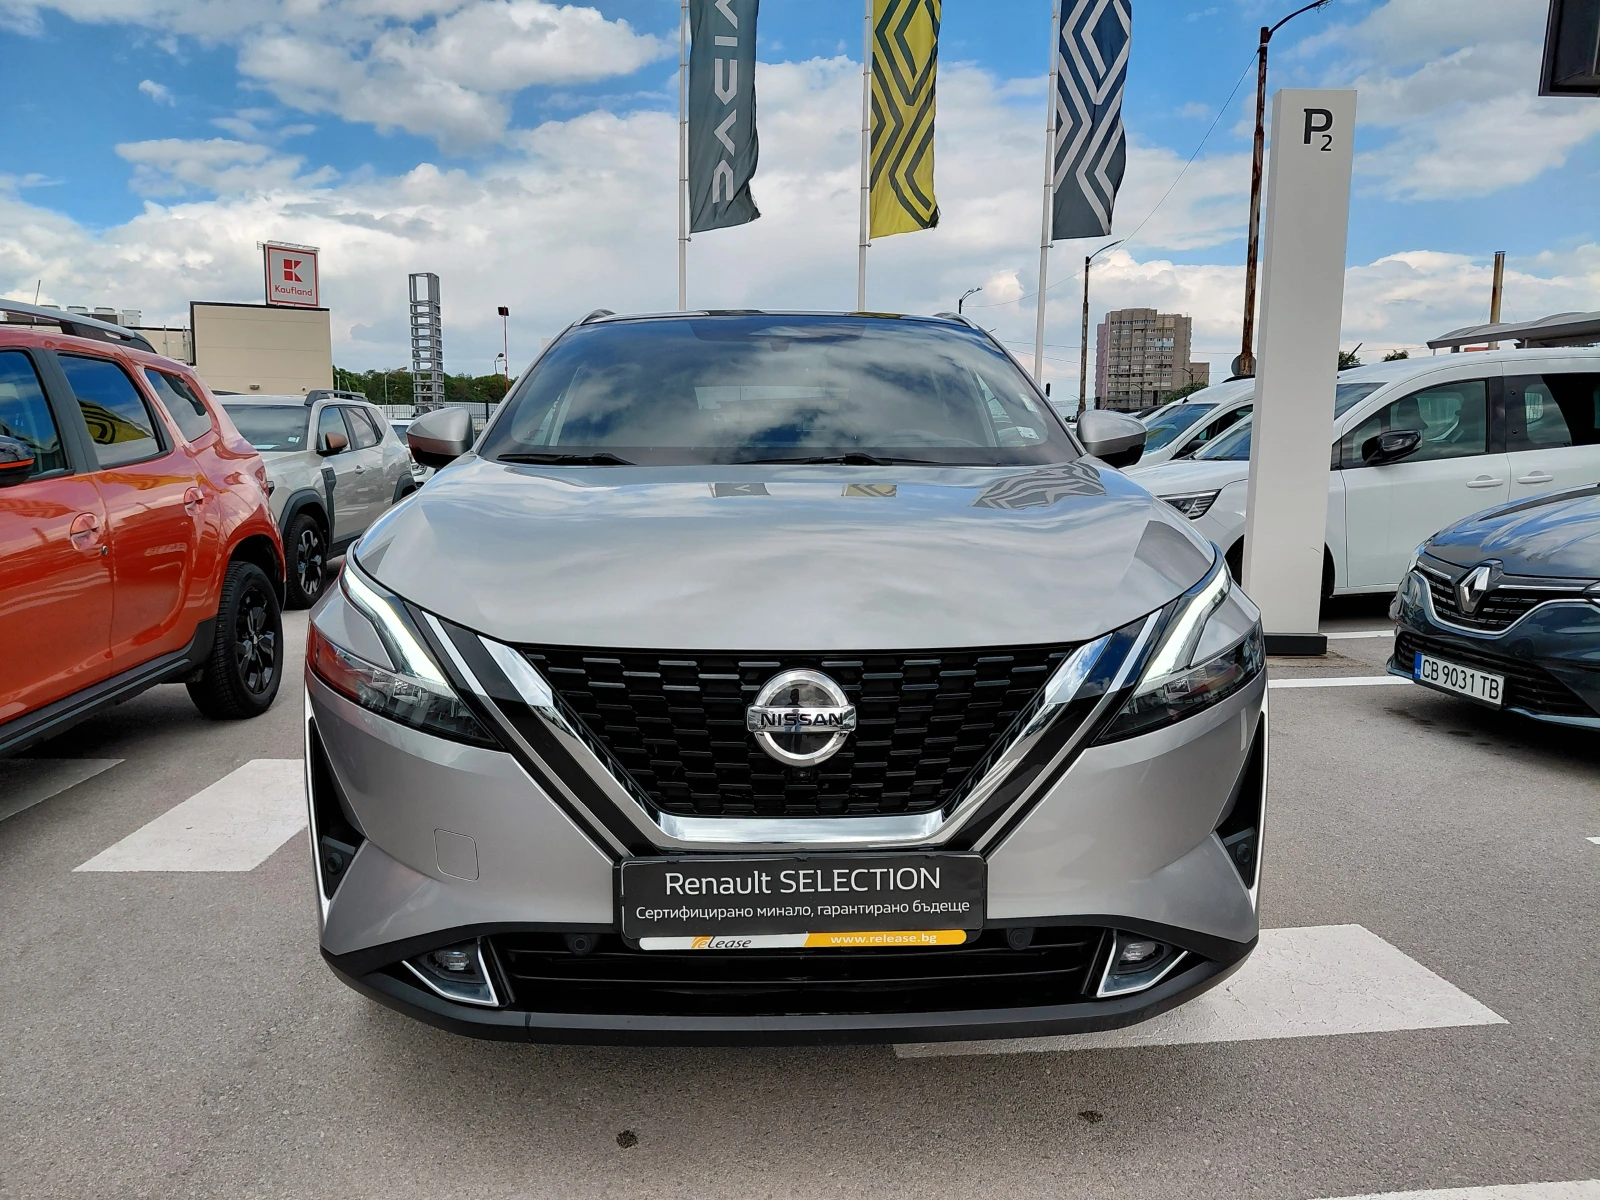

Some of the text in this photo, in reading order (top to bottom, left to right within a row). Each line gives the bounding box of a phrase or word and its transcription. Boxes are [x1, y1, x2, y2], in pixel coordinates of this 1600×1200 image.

[274, 284, 313, 297] Kaufland
[1422, 659, 1500, 700] CB 9031 TB
[760, 712, 844, 726] NISSAN
[665, 867, 940, 895] Renault SELECTION
[636, 899, 970, 921] Сертифицирано минало, гарантирано бъдеще
[830, 933, 937, 944] www.release.bg
